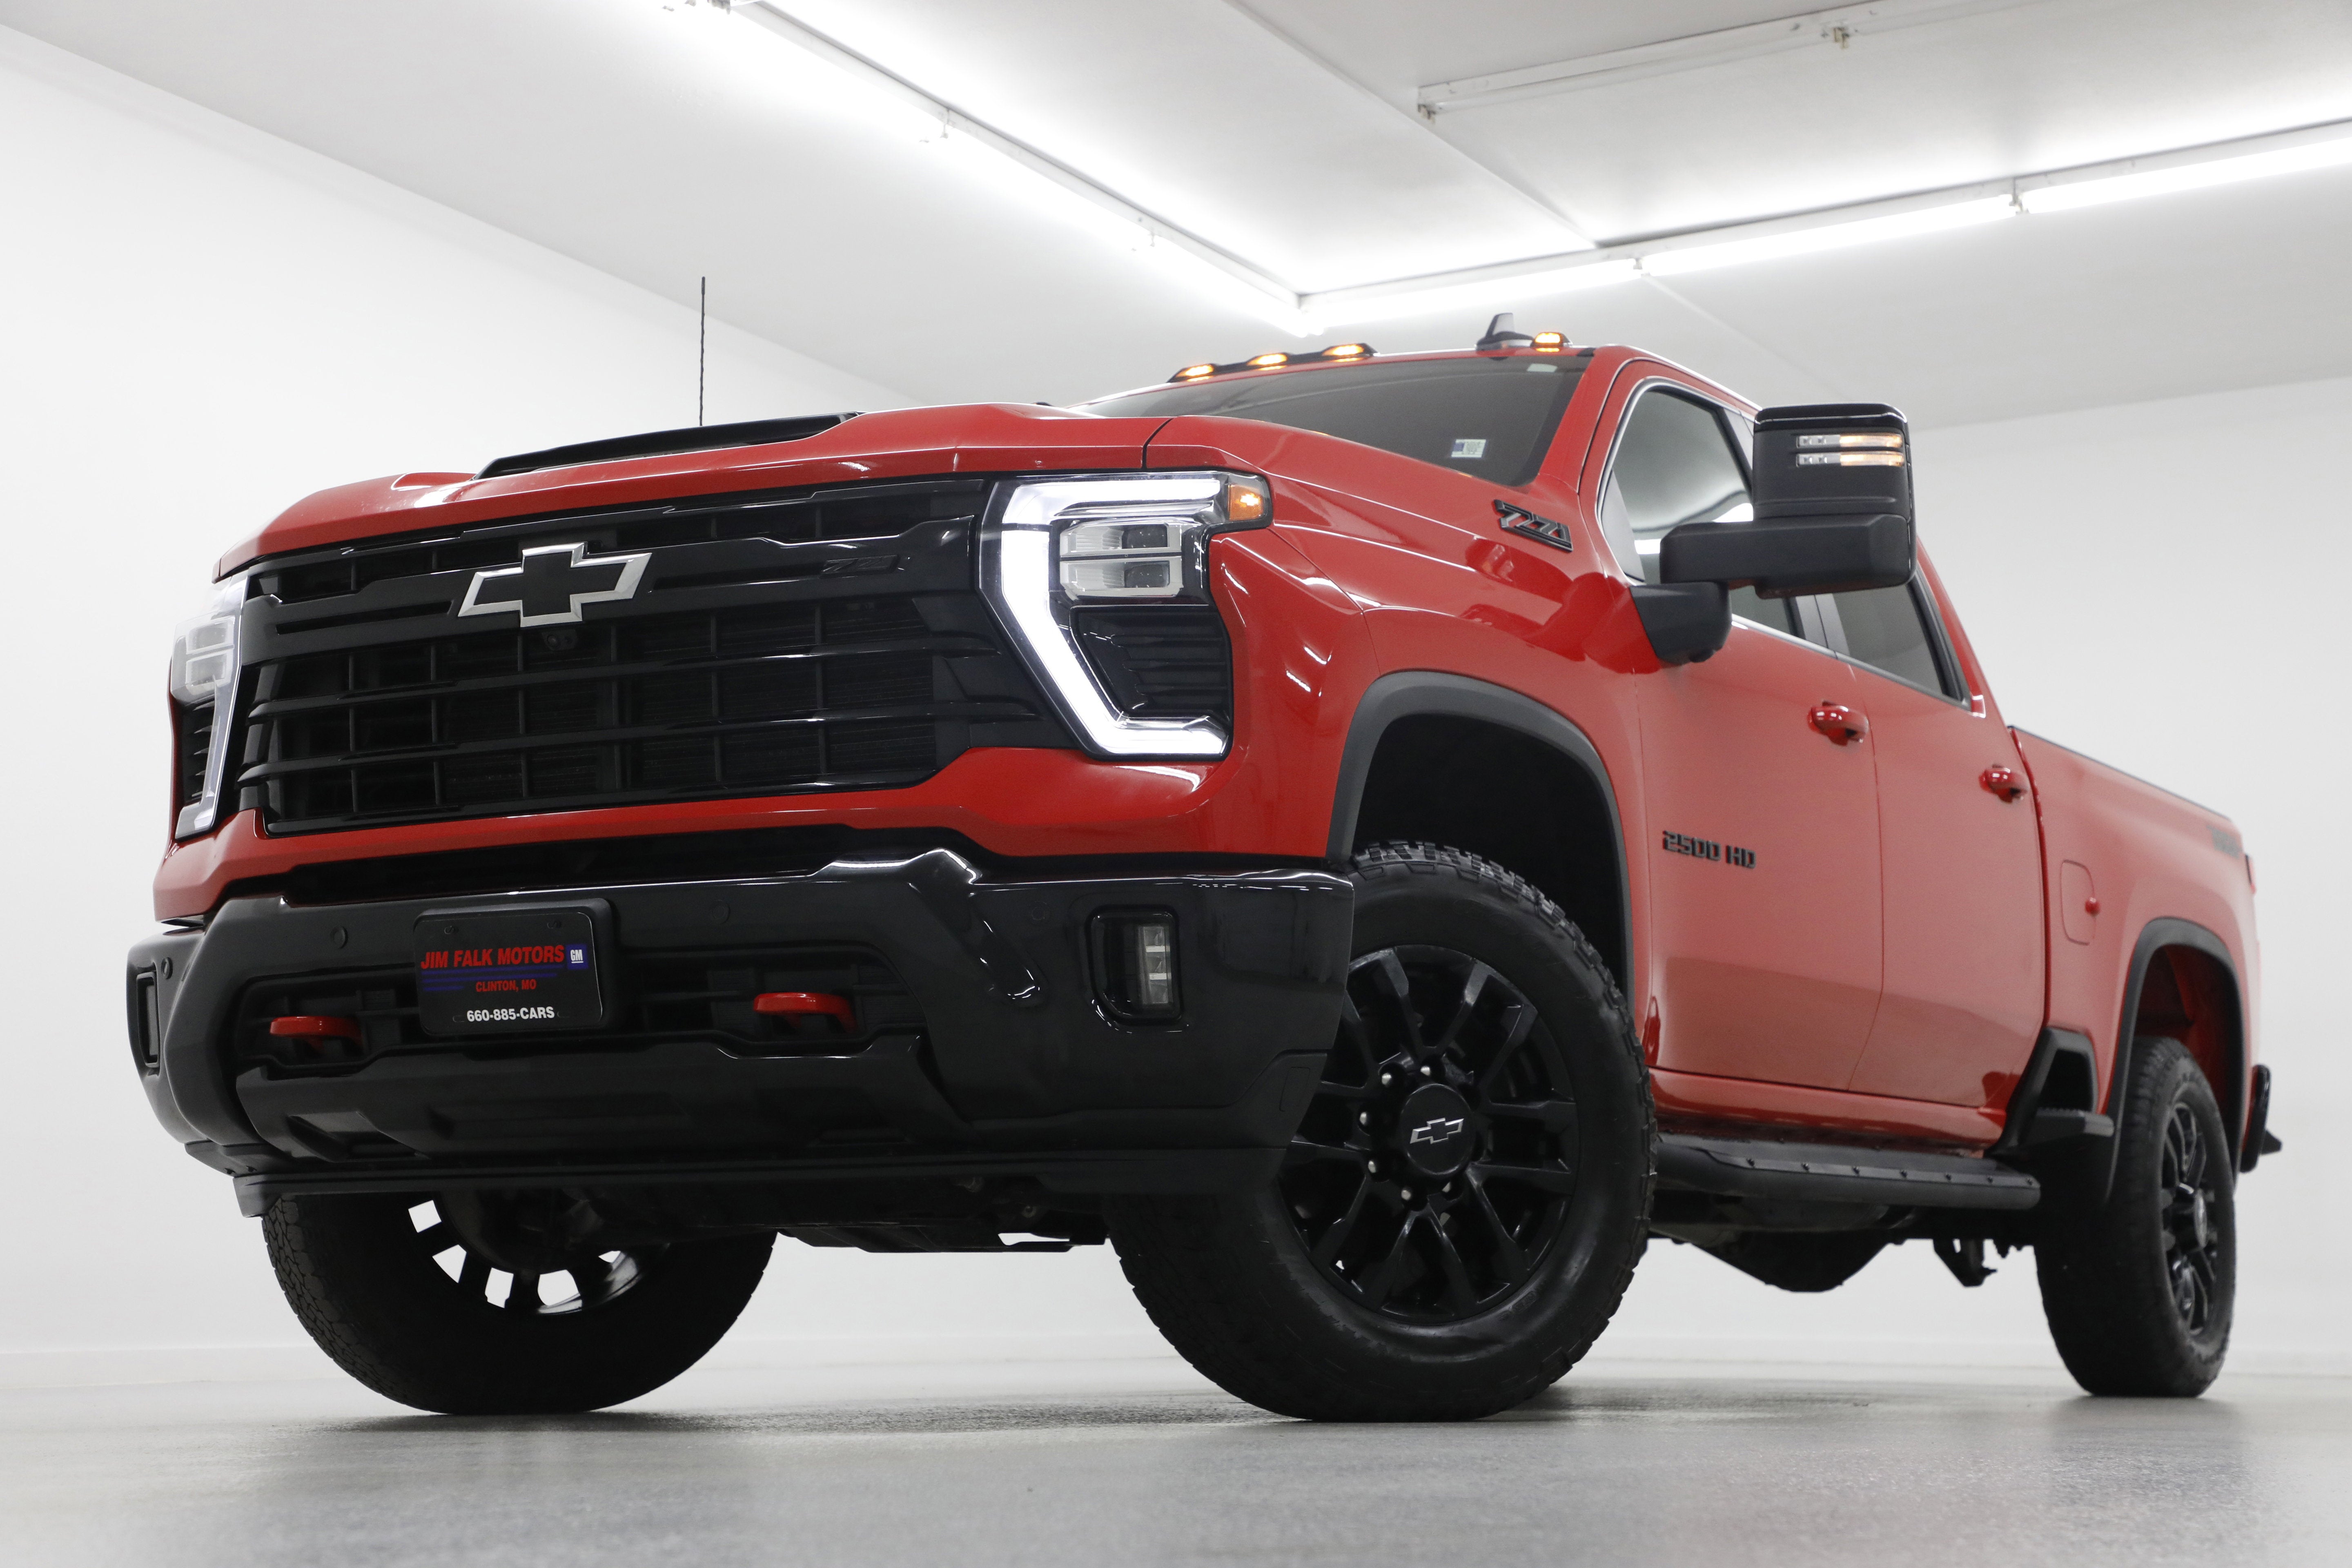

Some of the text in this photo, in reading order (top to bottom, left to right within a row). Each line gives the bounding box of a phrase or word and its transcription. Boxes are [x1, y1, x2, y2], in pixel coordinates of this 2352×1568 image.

[1494, 499, 1573, 552] Z71
[1662, 831, 1756, 869] 2500 HD
[421, 945, 565, 969] JIM FALK MOTORS
[570, 949, 584, 962] GM
[476, 979, 537, 992] CLINTON, MO
[466, 1007, 555, 1022] 660-885-CARS
